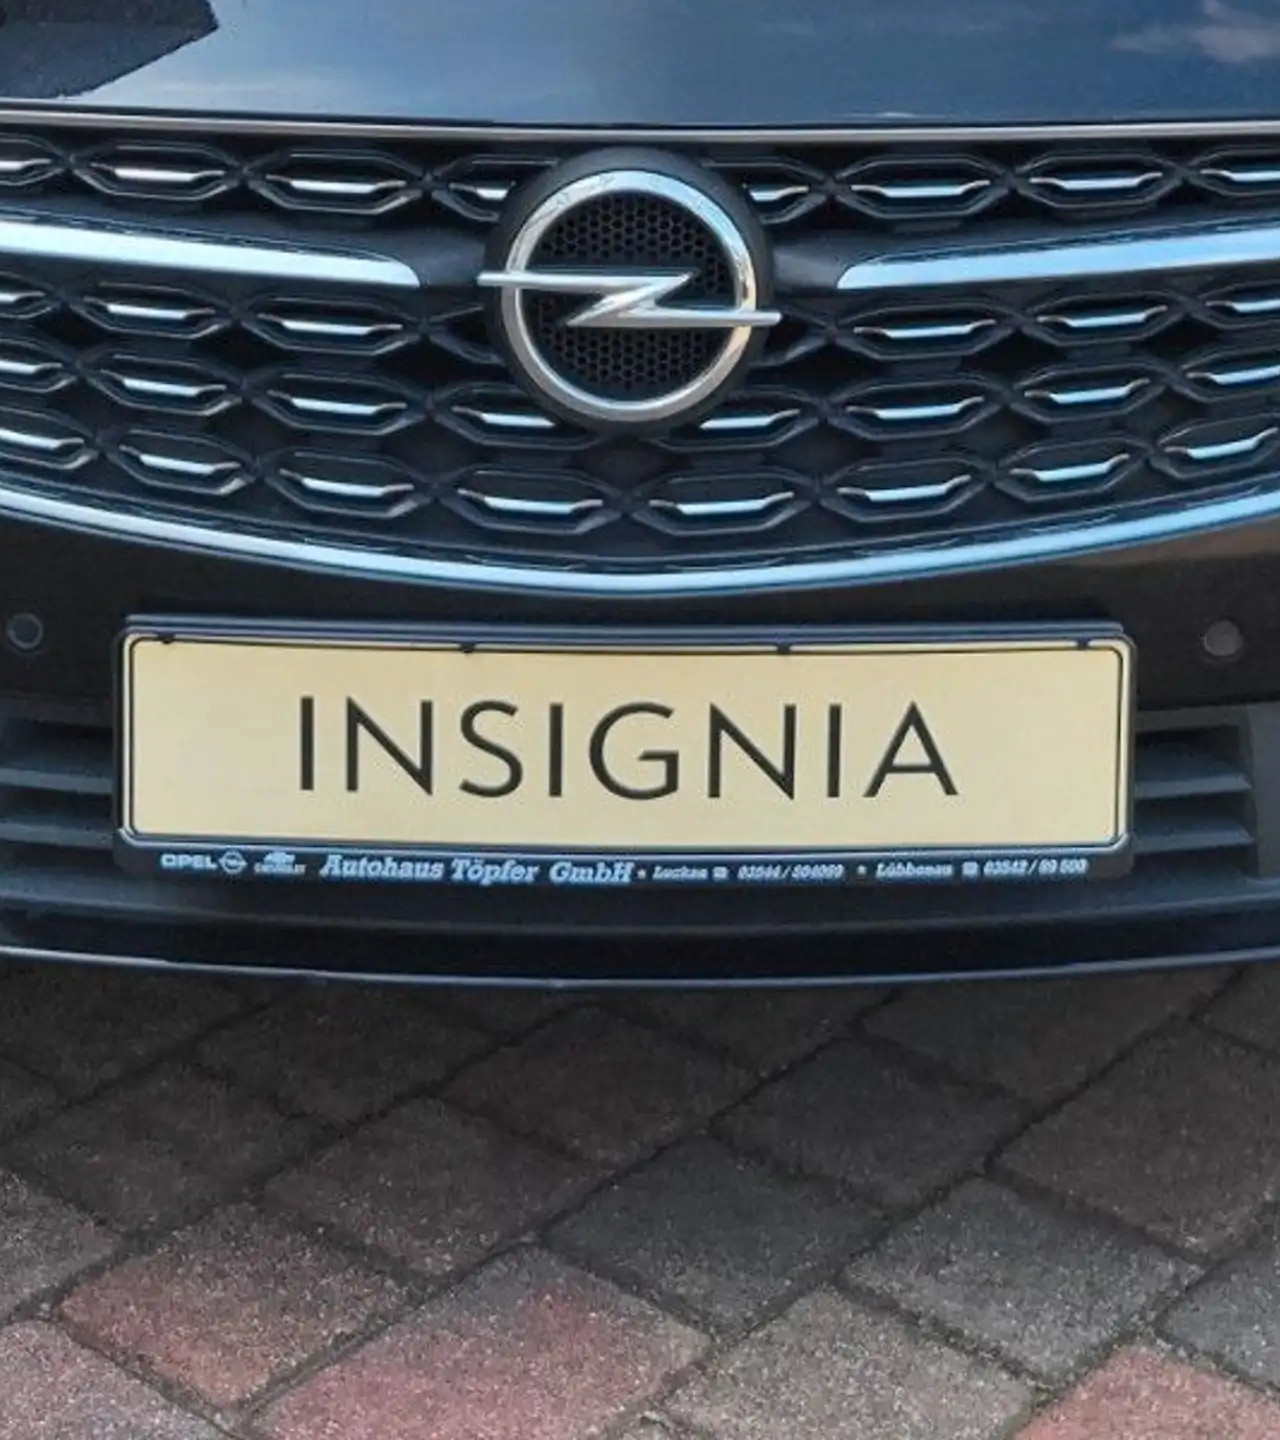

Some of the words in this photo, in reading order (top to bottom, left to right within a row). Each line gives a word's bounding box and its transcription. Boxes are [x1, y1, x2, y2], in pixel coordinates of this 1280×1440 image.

[300, 695, 959, 800] INSIGNIA
[160, 854, 218, 870] OPEL
[320, 854, 444, 879] Autohaus
[451, 857, 539, 885] Töpfer
[548, 860, 635, 883] GmbH
